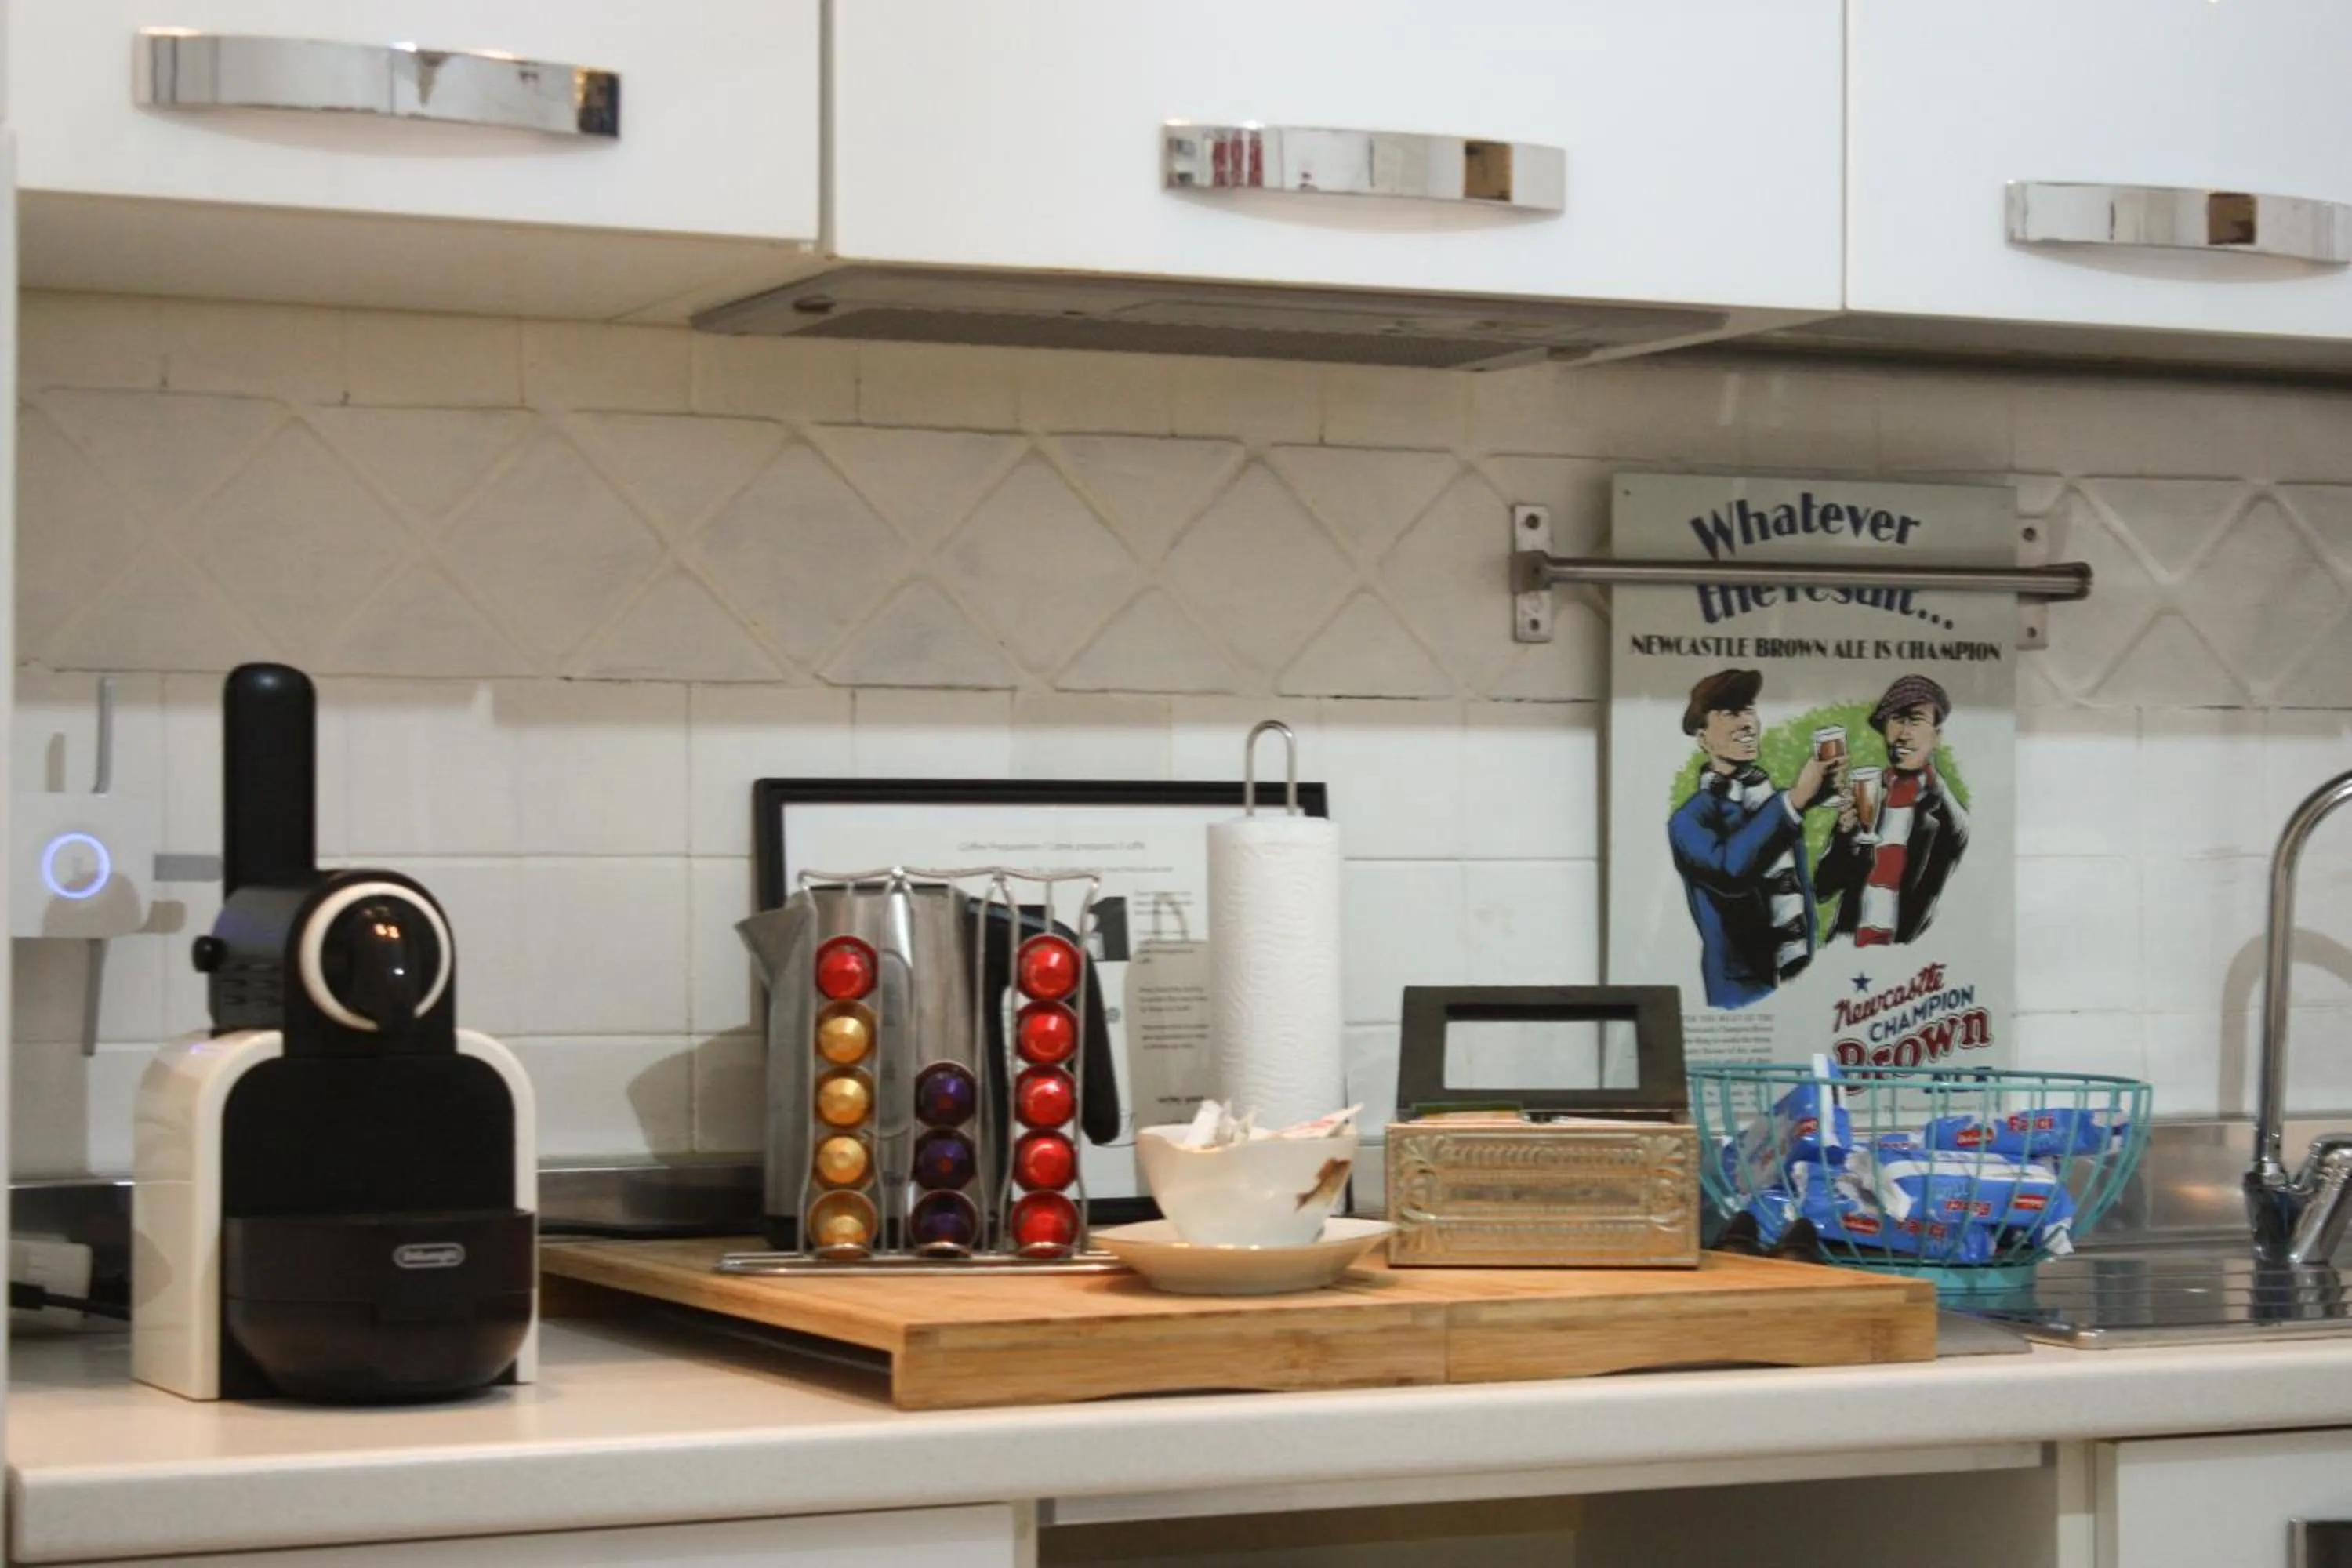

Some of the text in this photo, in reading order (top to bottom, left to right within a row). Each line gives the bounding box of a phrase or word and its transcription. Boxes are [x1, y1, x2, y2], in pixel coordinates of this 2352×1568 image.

[1689, 492, 1922, 560] Whatever
[1631, 633, 2002, 662] NEWCASTLE BROWN ALE IS CHAMPION
[1832, 962, 1947, 1033] Newcastle
[1868, 985, 1975, 1042] CHAMPION
